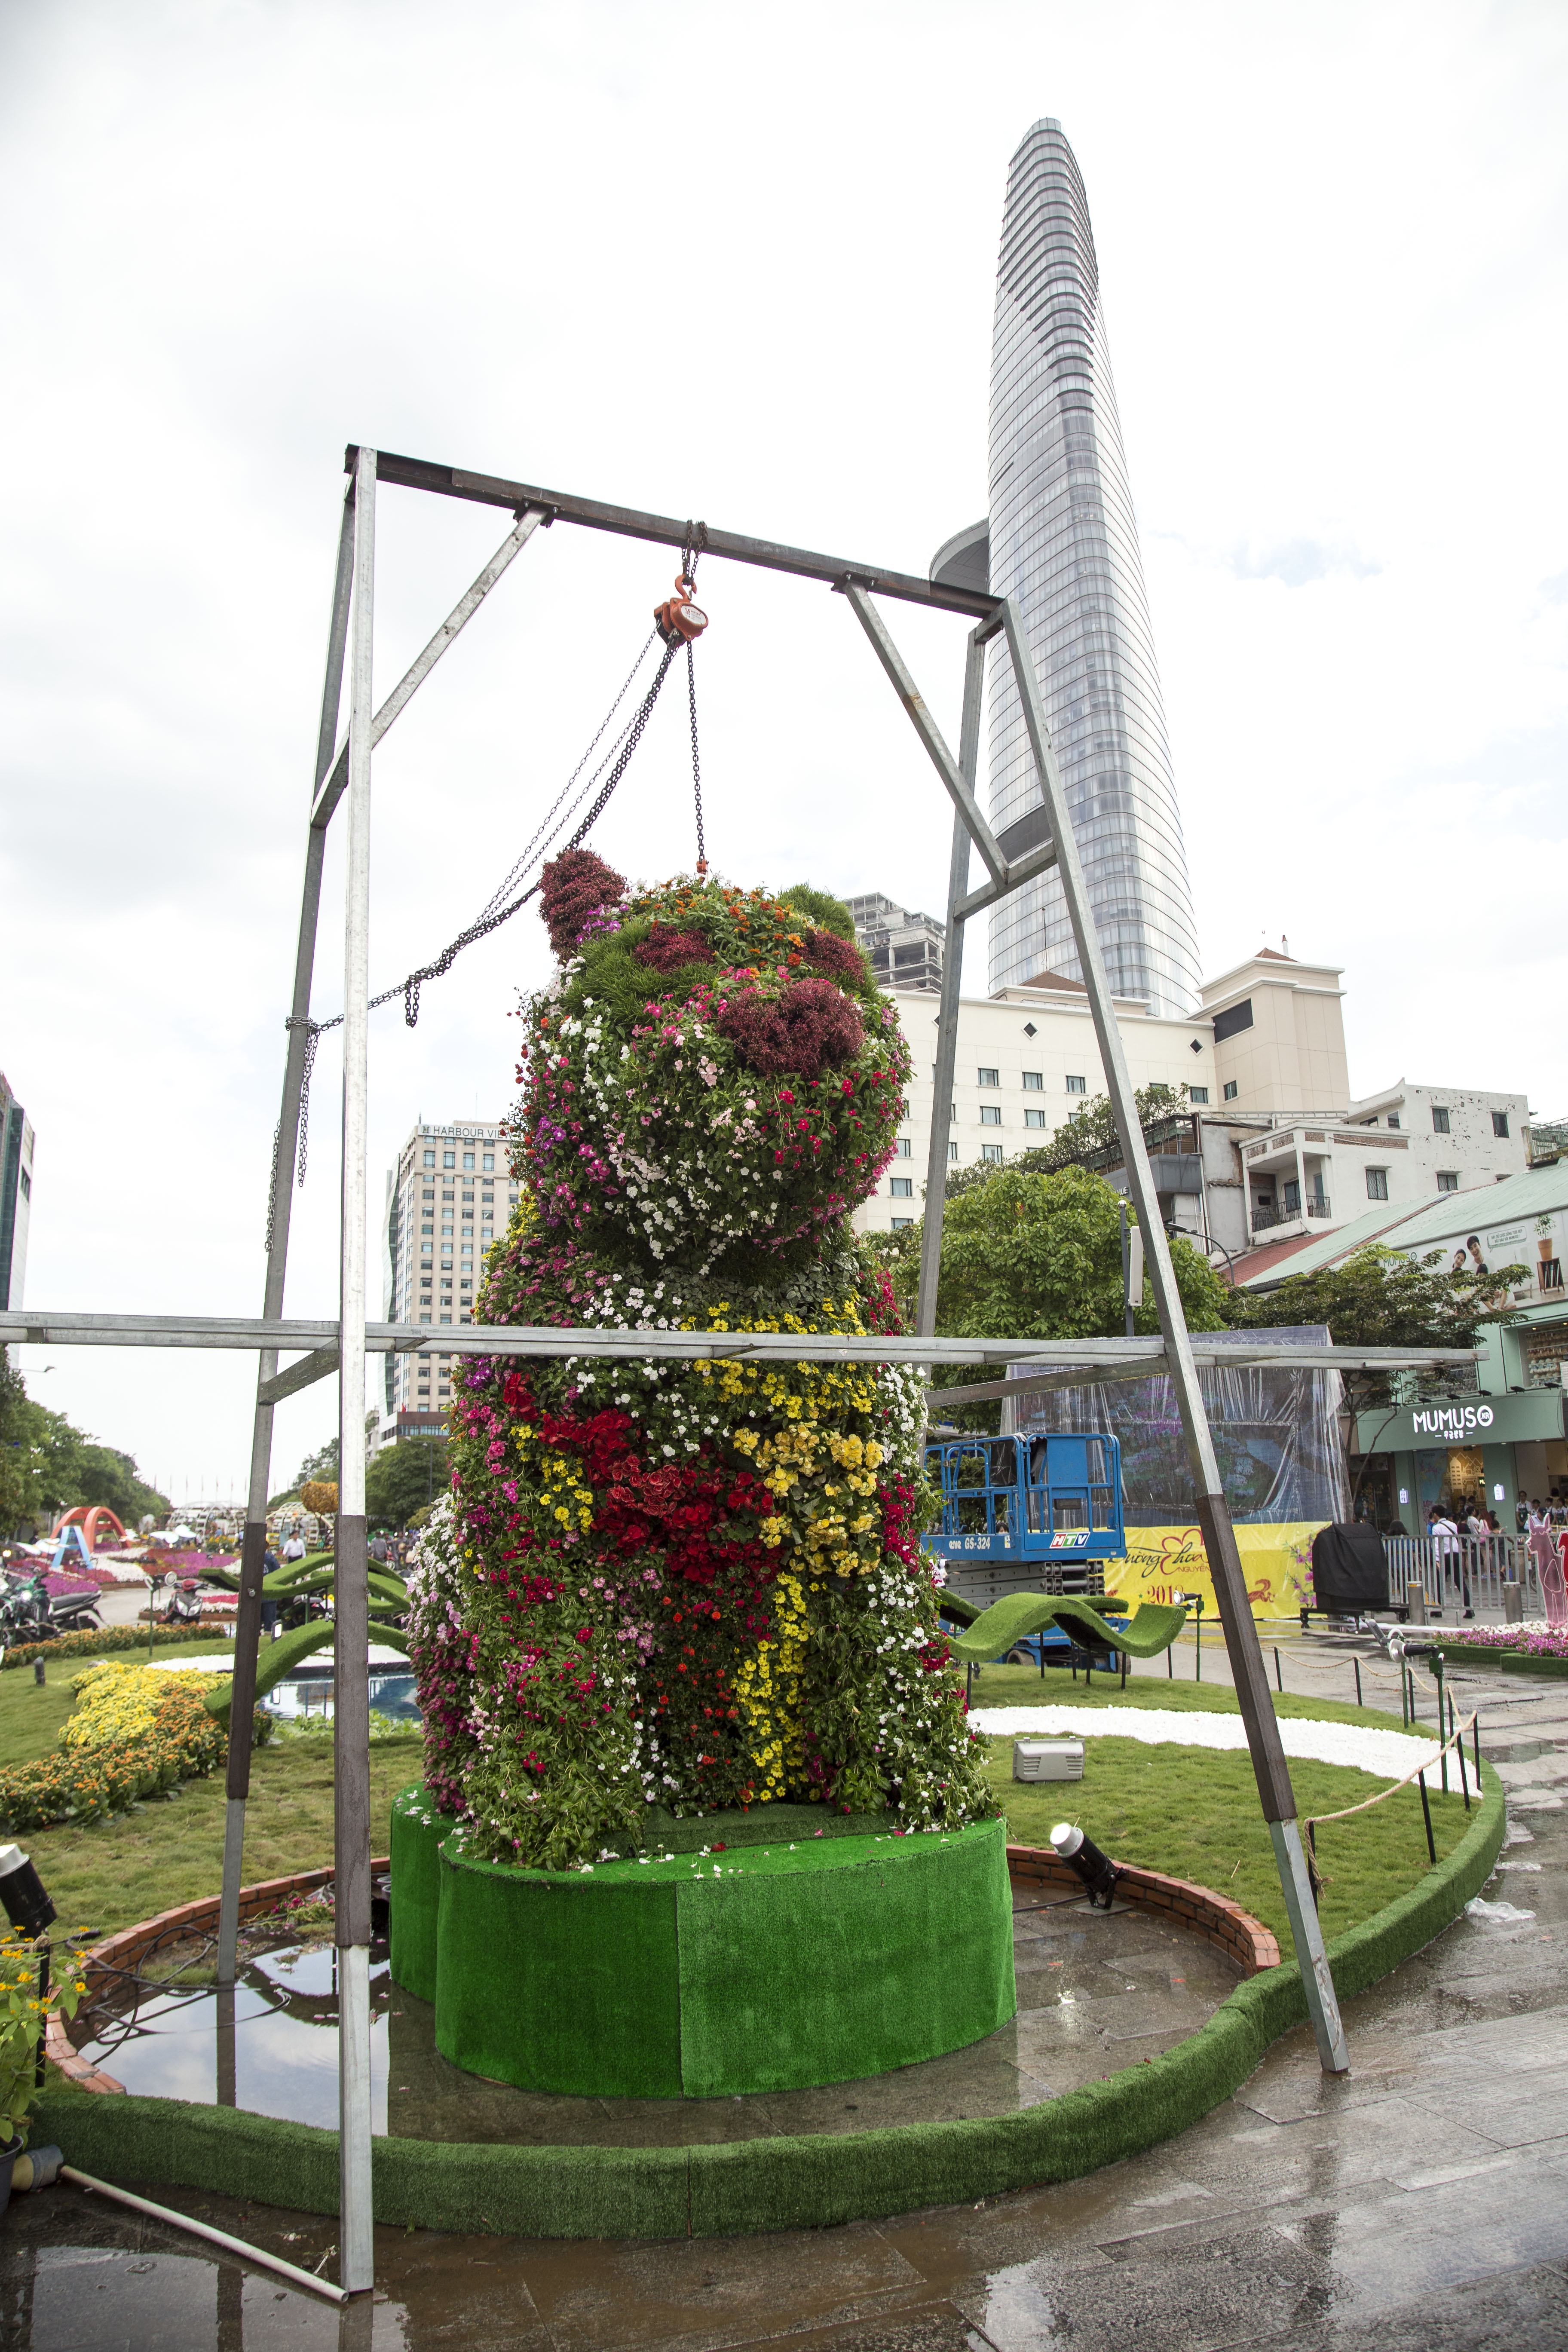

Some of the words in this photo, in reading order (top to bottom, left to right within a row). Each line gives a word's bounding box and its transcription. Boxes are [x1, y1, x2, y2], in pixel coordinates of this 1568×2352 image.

[433, 1126, 484, 1138] HARBOUR
[1413, 1405, 1494, 1433] MUMUSO
[965, 1537, 990, 1550] GS-324
[1052, 1534, 1088, 1546] HTV
